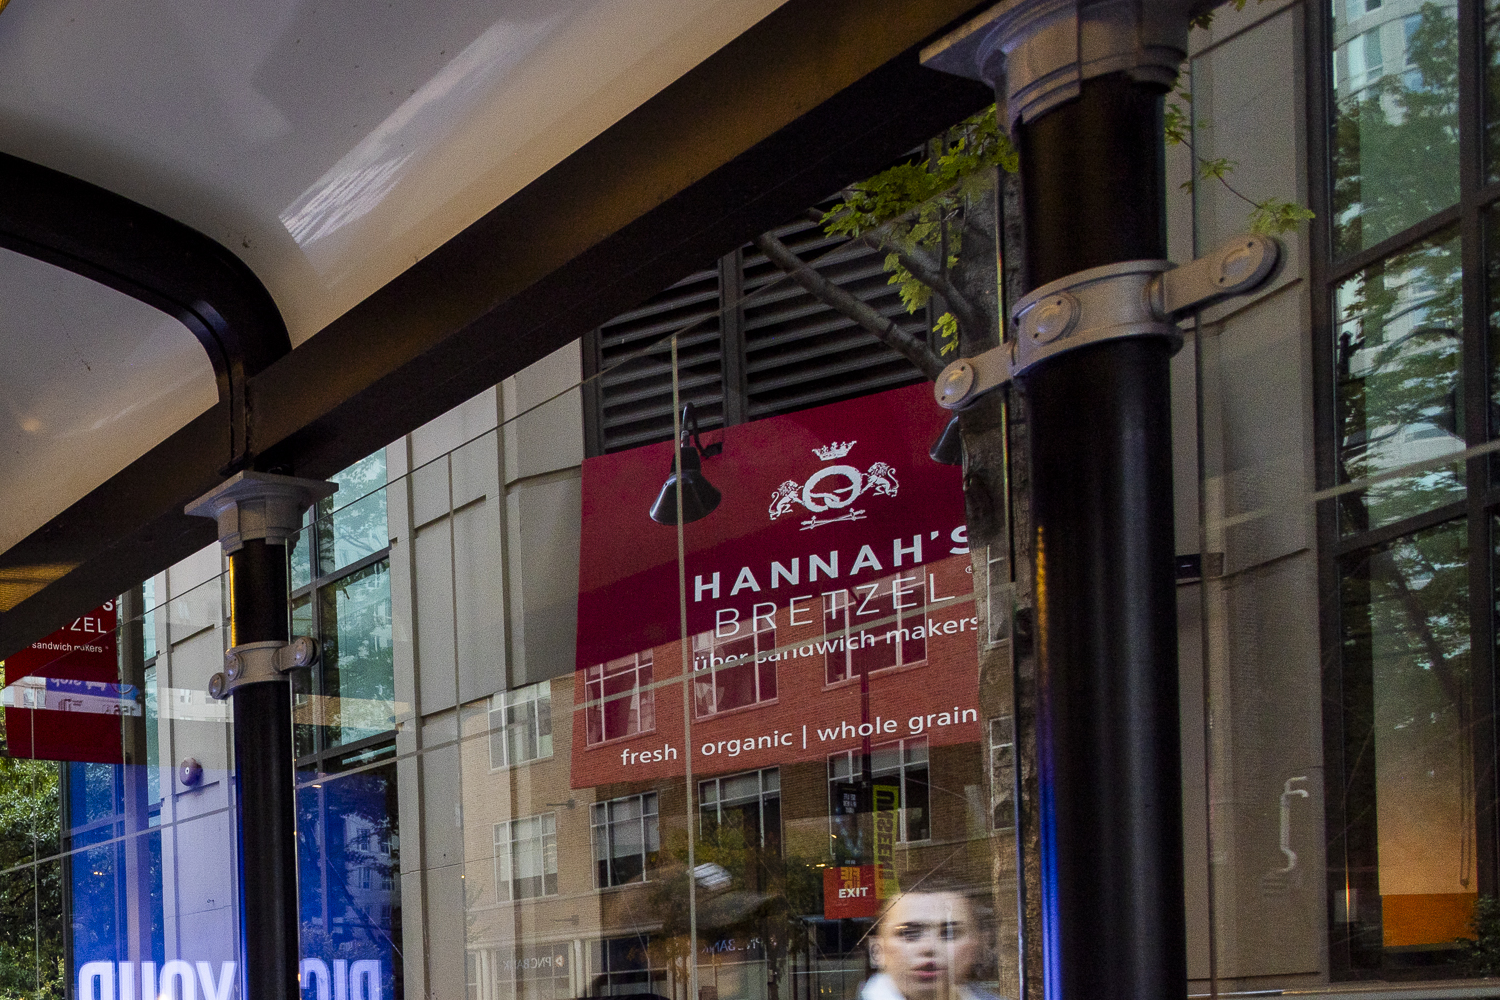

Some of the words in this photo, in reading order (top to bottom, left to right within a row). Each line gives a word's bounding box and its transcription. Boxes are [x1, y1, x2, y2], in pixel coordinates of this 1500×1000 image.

[694, 525, 970, 602] HANNAH'S
[716, 574, 956, 638] BRETZEL
[32, 642, 72, 652] sandwich
[756, 630, 874, 664] sandwich
[702, 730, 792, 756] organic
[818, 717, 898, 742] whole
[908, 706, 978, 734] grain
[620, 744, 677, 767] fresh
[839, 887, 868, 898] EXIT
